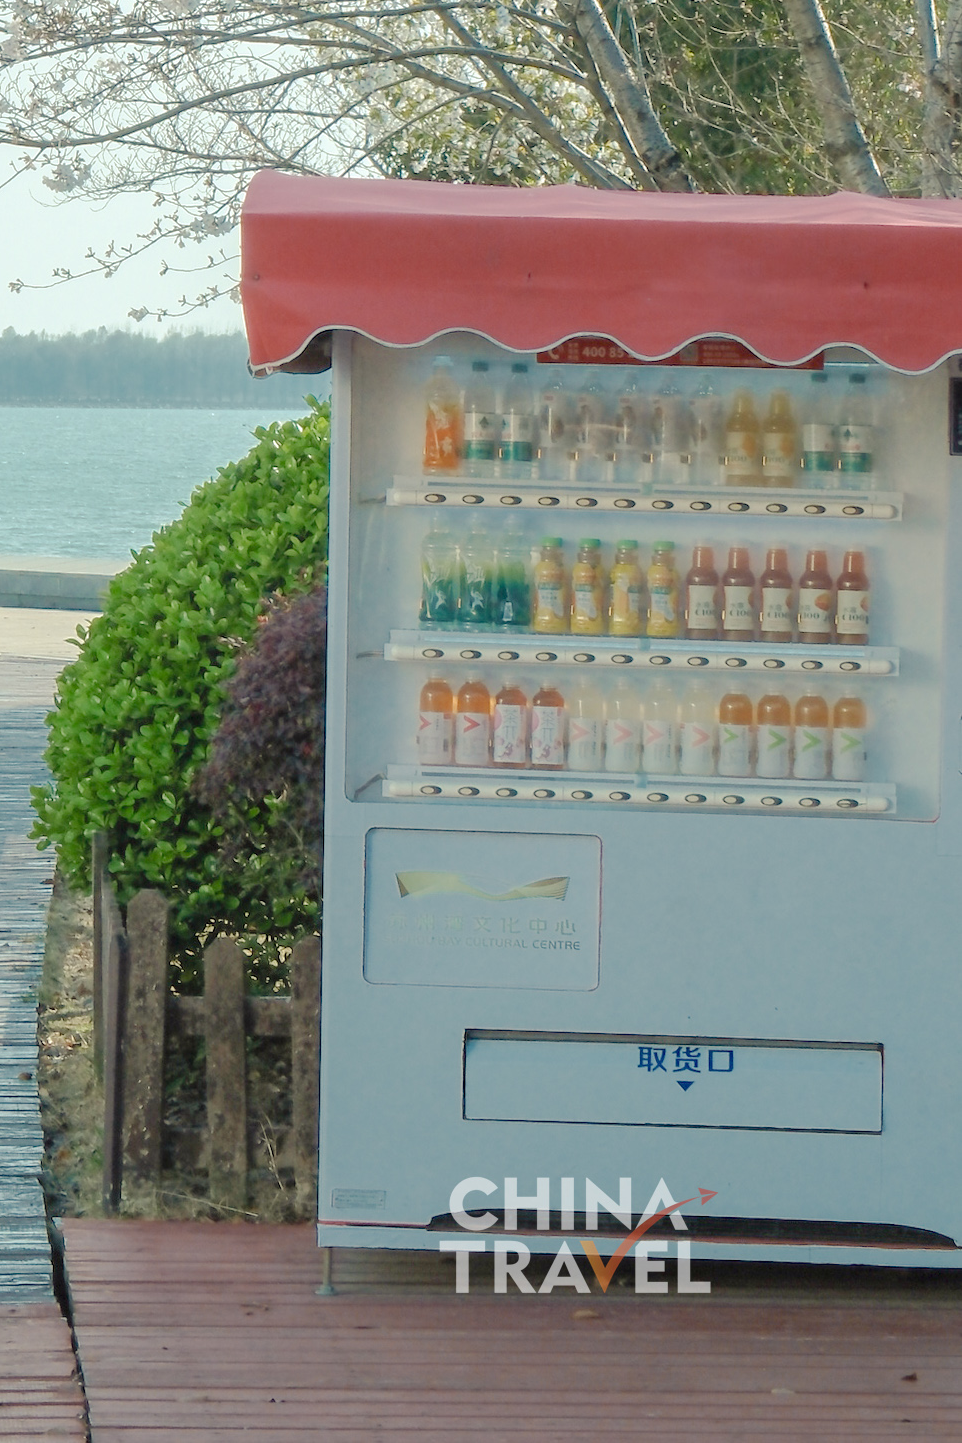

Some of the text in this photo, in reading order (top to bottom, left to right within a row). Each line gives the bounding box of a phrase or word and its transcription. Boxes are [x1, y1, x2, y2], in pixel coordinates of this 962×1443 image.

[582, 346, 606, 358] 400
[438, 936, 462, 946] BAY
[465, 936, 528, 949] CULTURAL
[532, 939, 581, 951] CENTRE
[637, 1046, 734, 1073] 取货口
